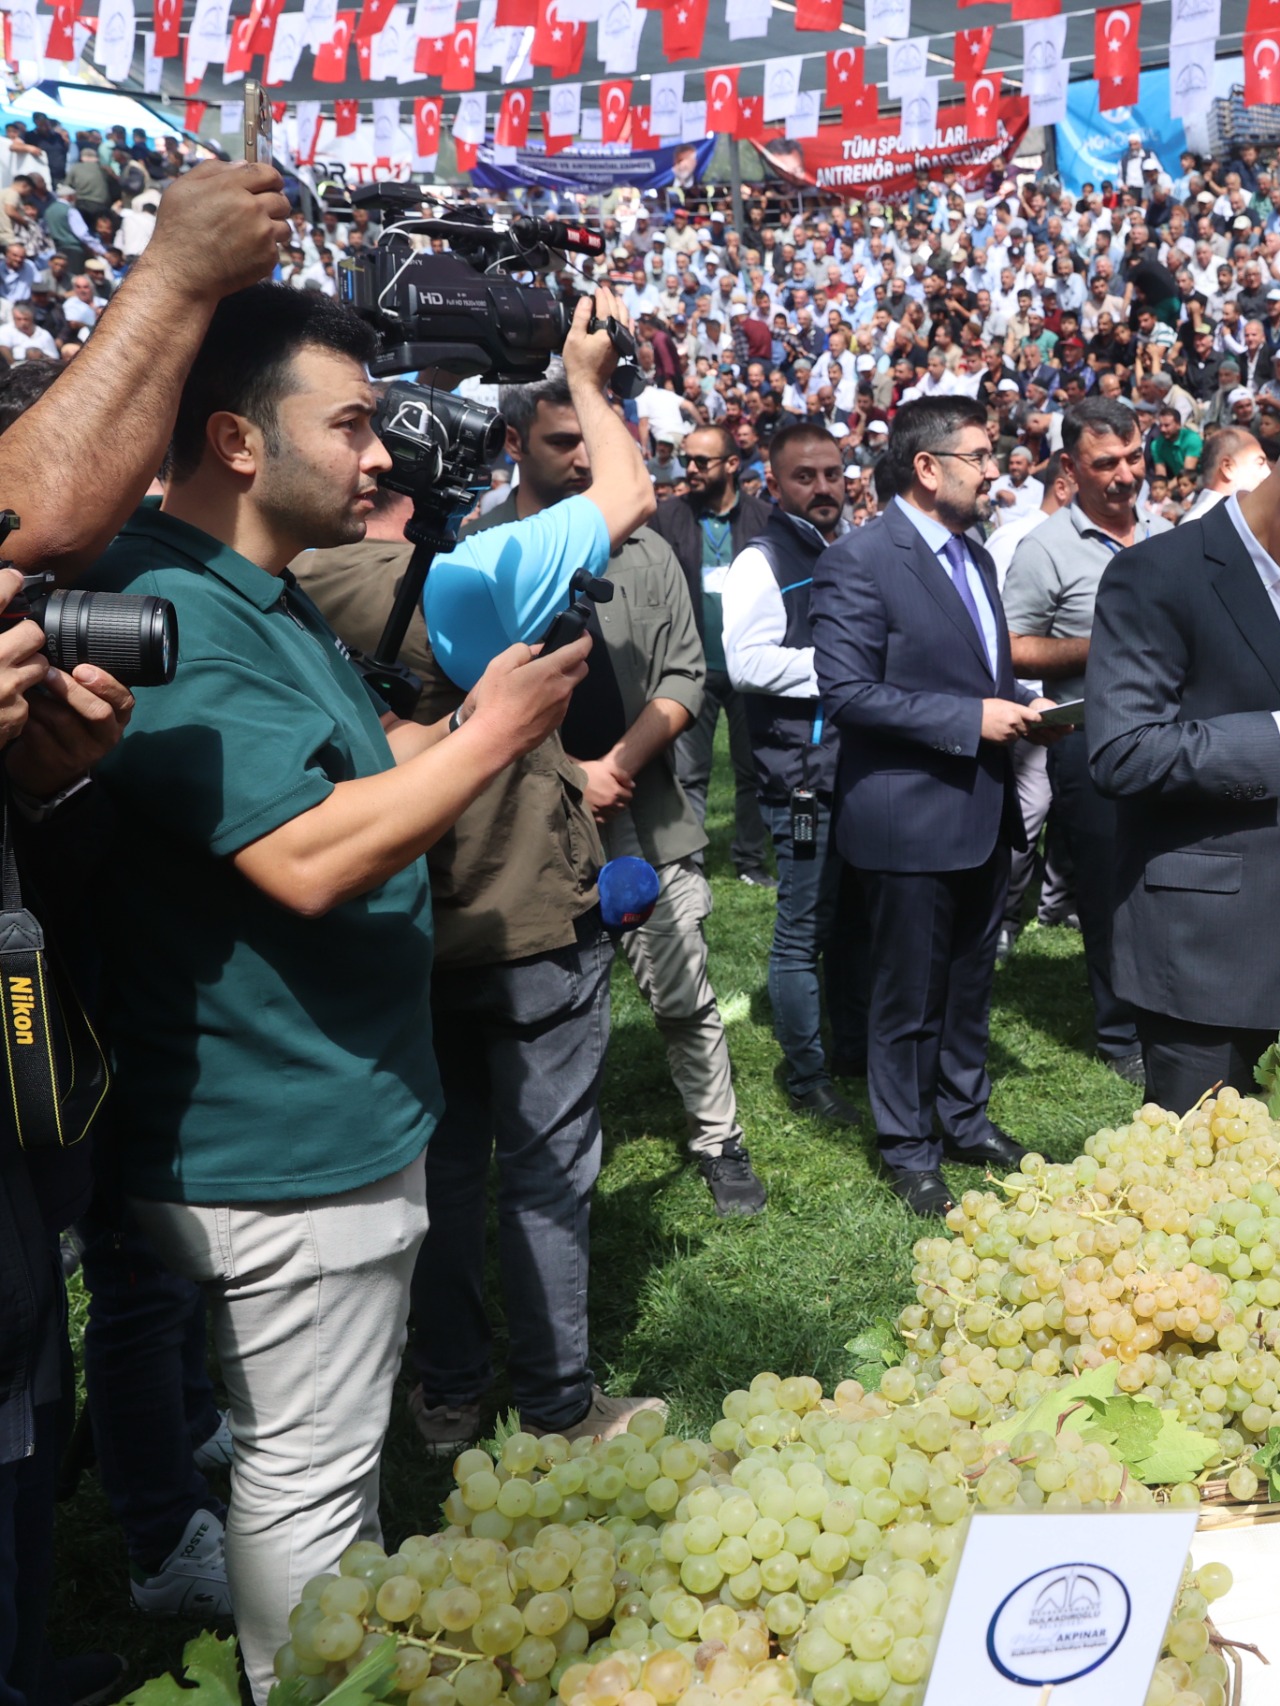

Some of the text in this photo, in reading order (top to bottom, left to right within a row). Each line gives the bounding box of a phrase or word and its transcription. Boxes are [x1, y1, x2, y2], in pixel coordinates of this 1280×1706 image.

[842, 134, 876, 160] TÜM
[816, 158, 893, 187] ANTRENÖR
[419, 291, 444, 305] HD
[8, 976, 35, 1045] Nikon
[1056, 1628, 1106, 1641] AKPINAR
